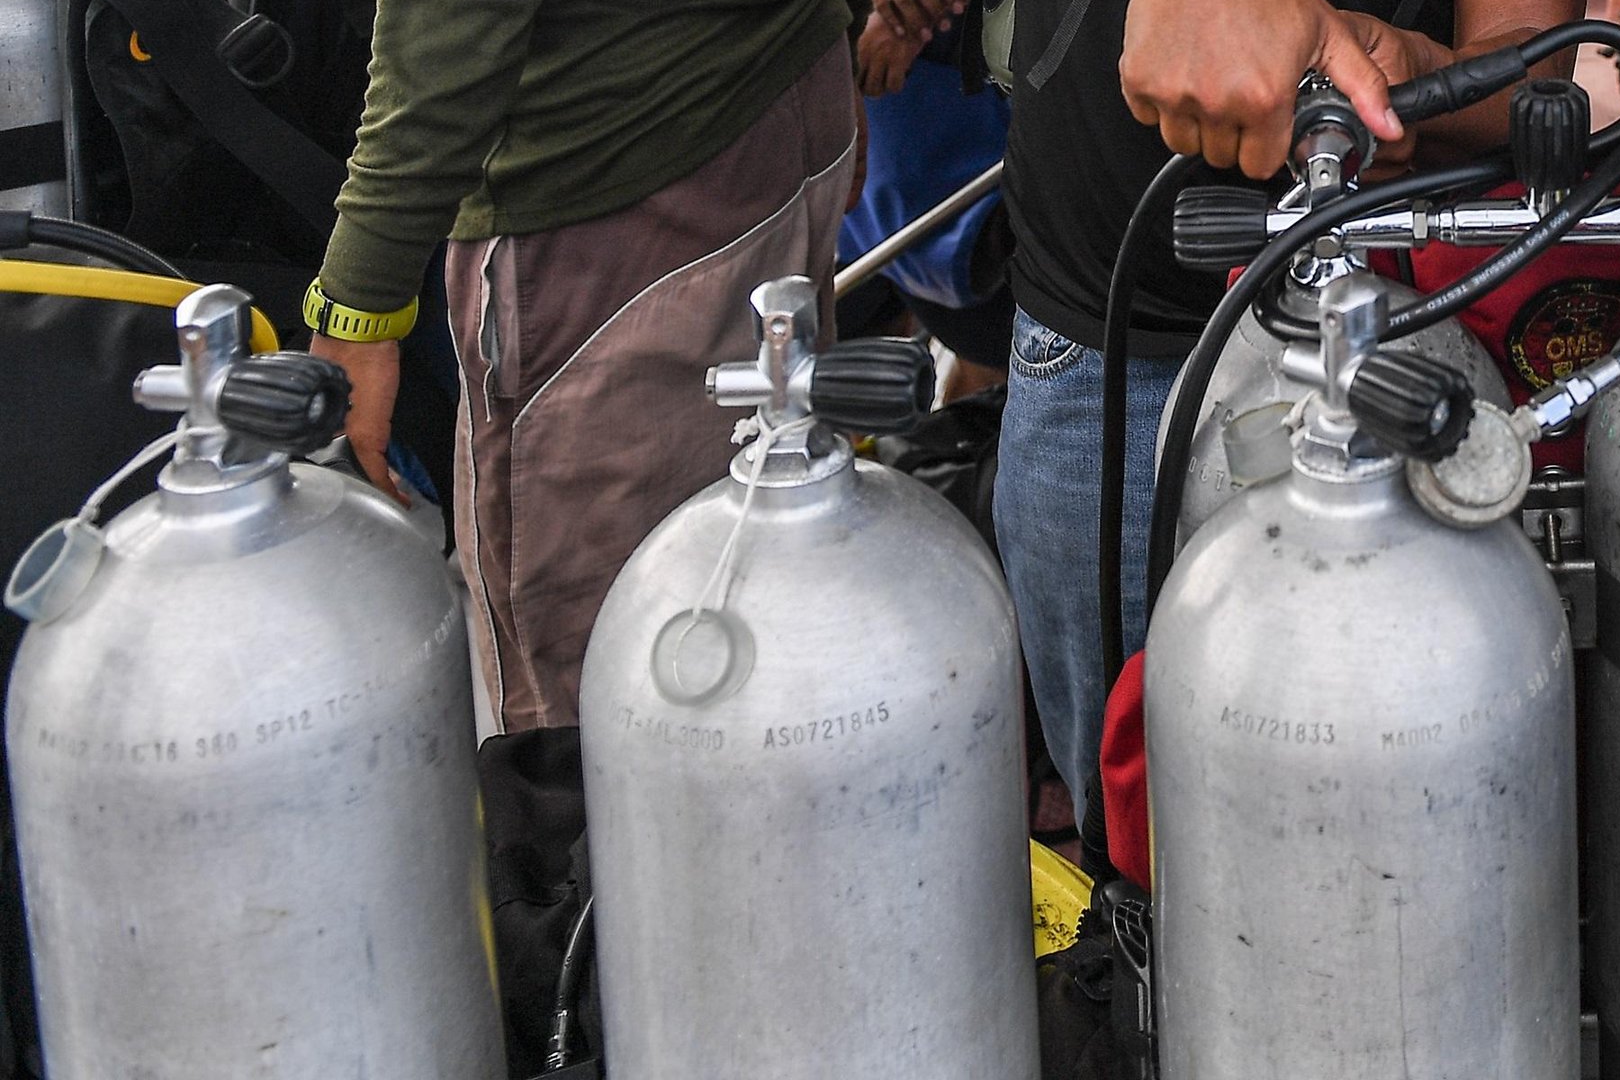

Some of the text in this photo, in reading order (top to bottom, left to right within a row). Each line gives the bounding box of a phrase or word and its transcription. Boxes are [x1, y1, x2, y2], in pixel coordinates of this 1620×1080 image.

[1473, 245, 1525, 288] PRESSURE
[1426, 282, 1468, 311] TESTED
[1545, 330, 1603, 362] OMS
[255, 709, 313, 745] SP12
[763, 700, 892, 750] AS0721845
